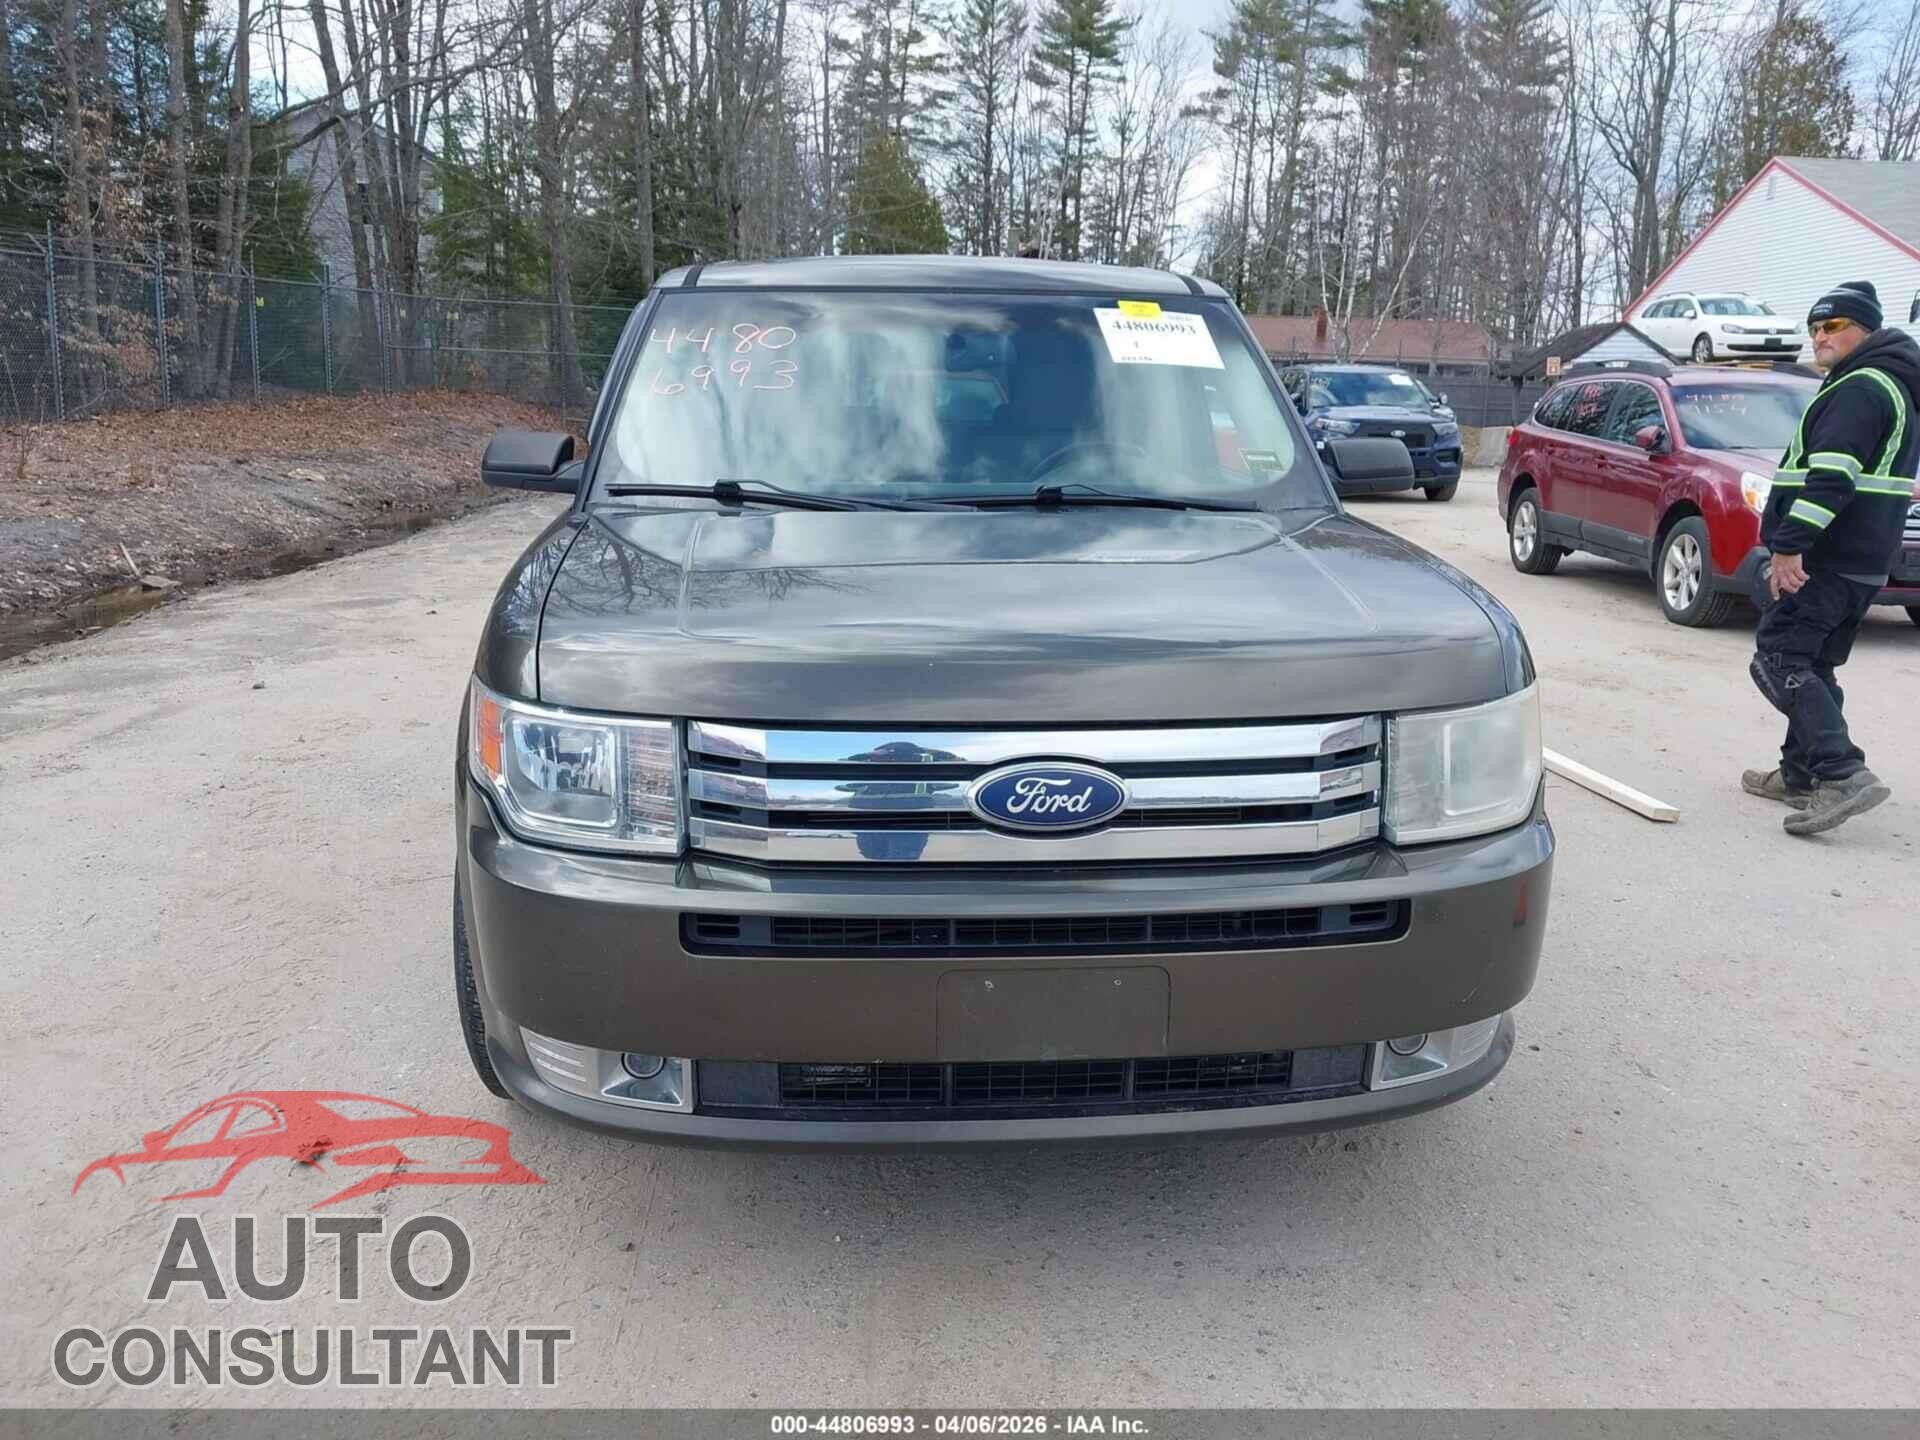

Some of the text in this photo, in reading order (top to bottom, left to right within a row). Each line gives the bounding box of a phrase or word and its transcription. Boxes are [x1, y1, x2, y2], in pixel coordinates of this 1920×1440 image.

[1111, 319, 1198, 337] 44806993
[652, 359, 800, 395] 6993
[1006, 777, 1094, 814] Ford
